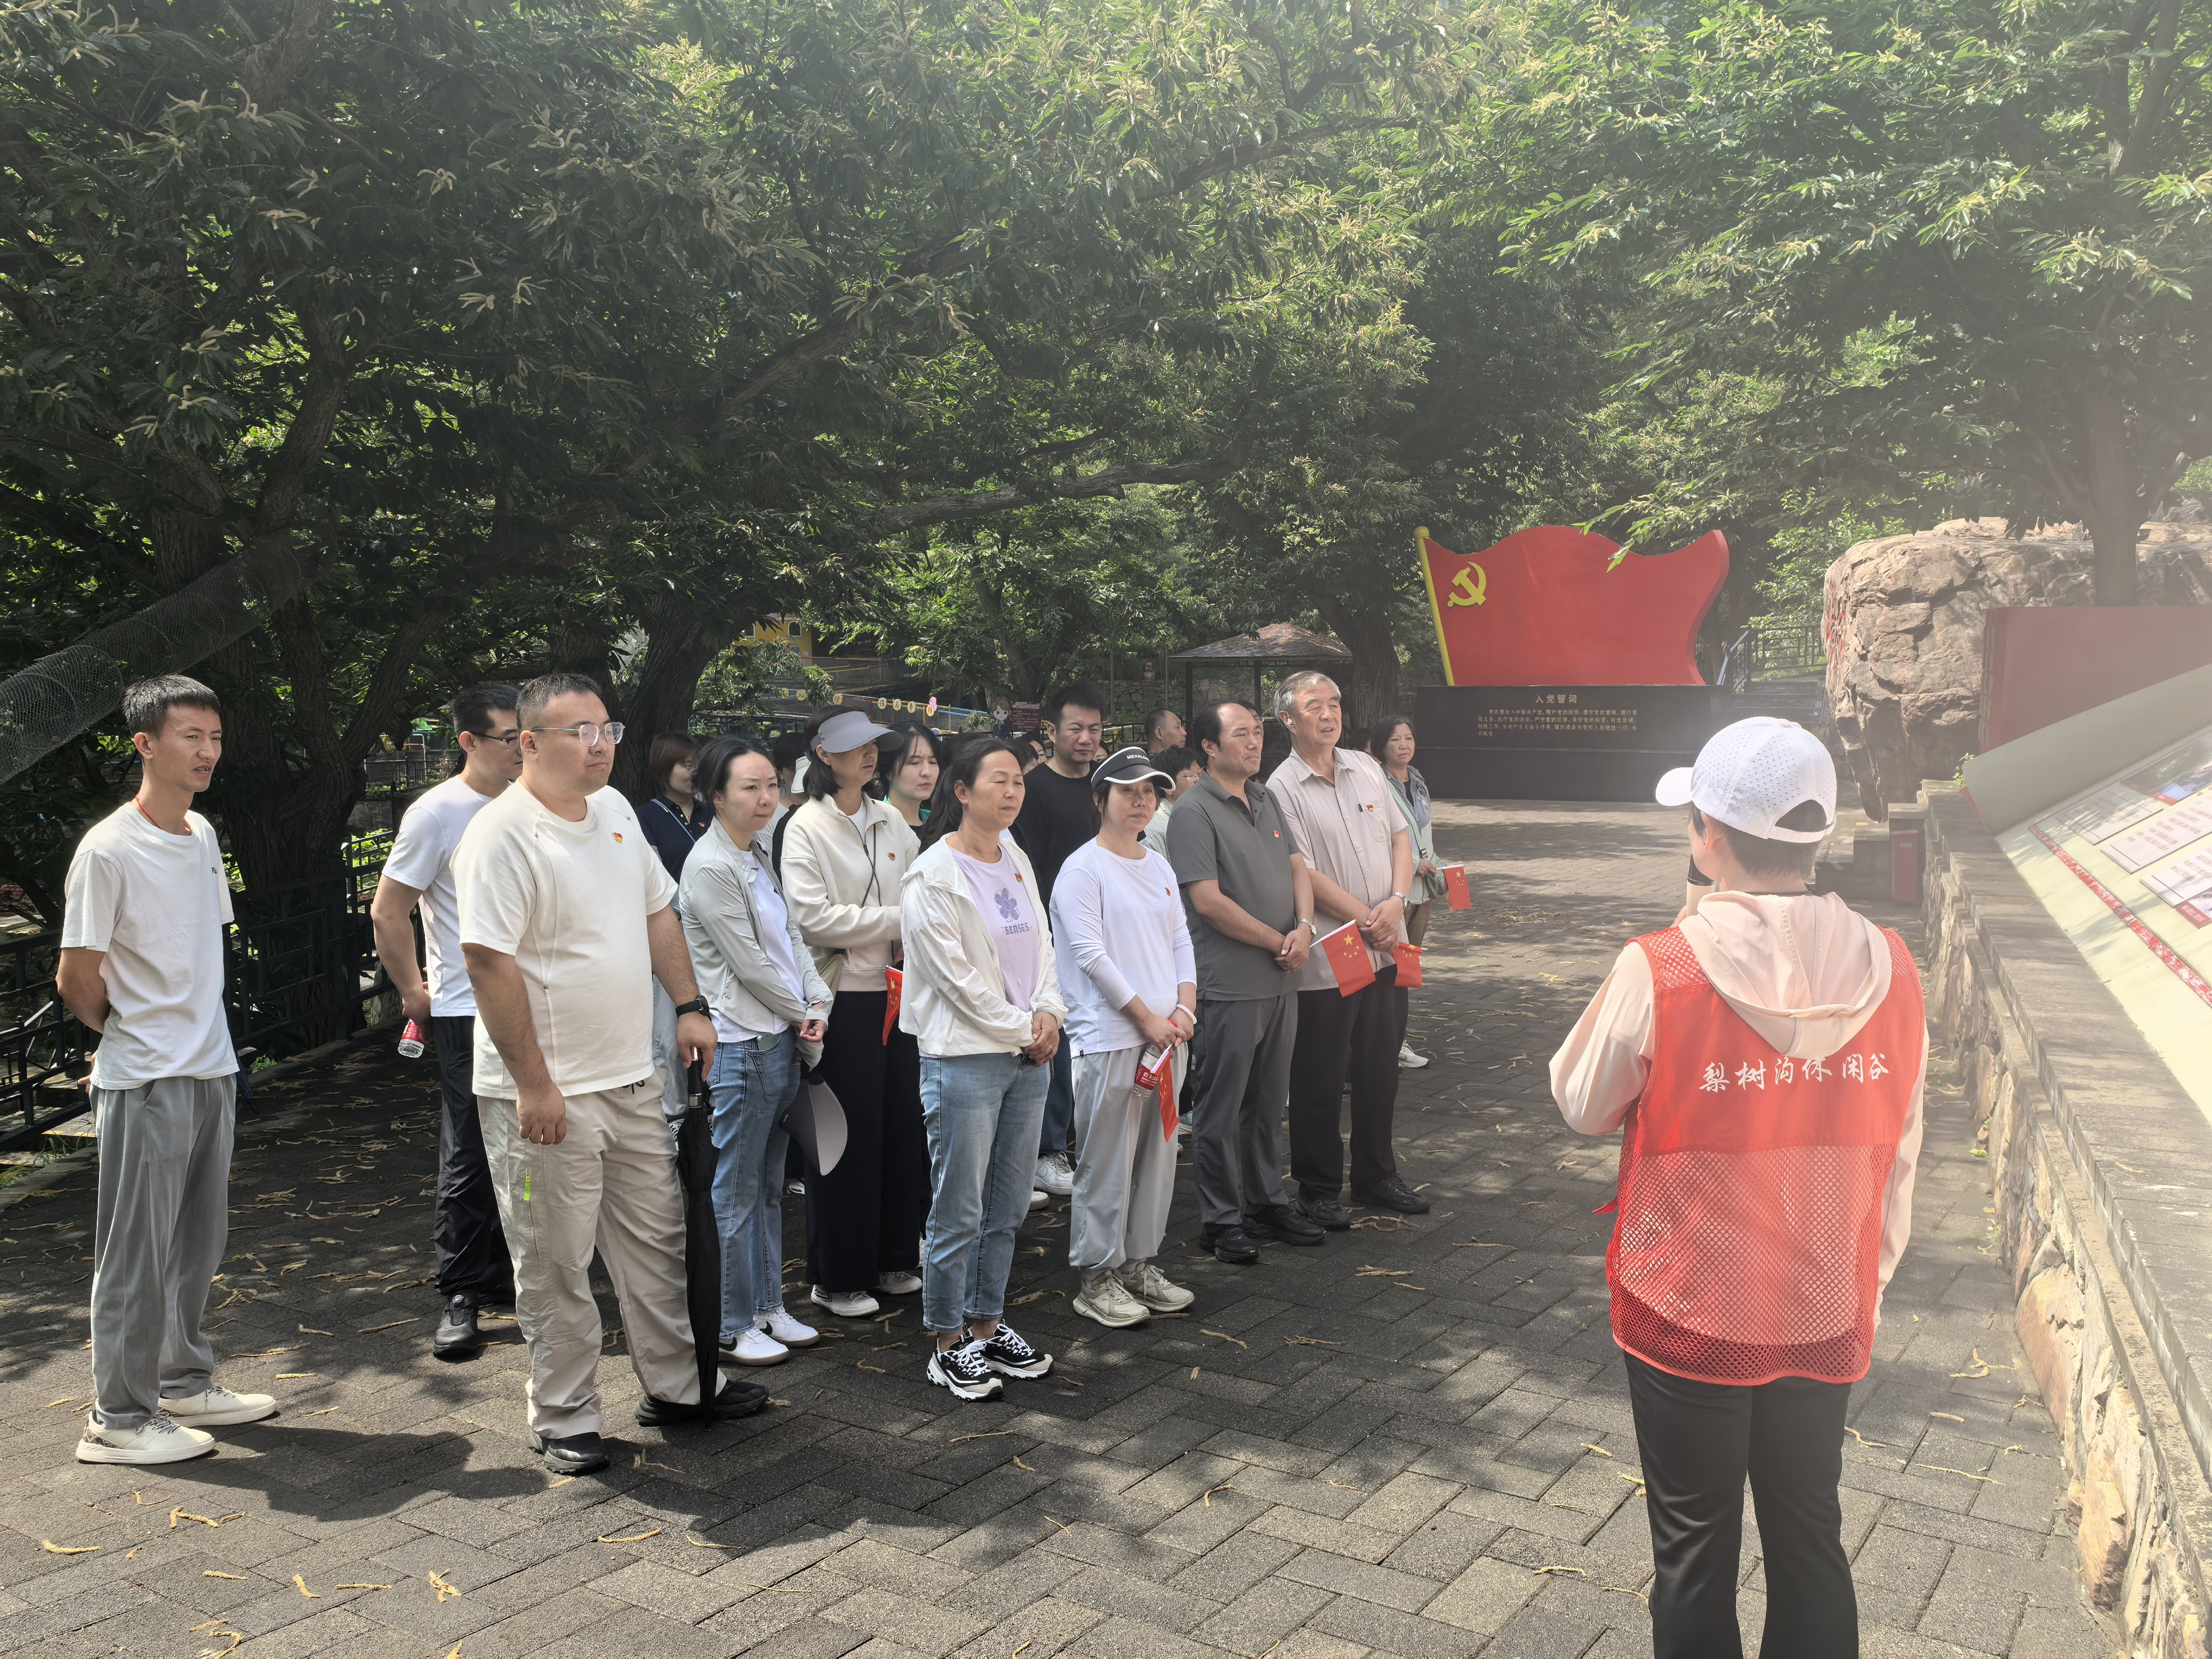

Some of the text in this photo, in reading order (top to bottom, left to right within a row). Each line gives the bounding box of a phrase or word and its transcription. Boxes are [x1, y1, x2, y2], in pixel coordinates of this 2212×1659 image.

[1535, 694, 1577, 704] 入党誓词
[1004, 922, 1029, 935] SENSES
